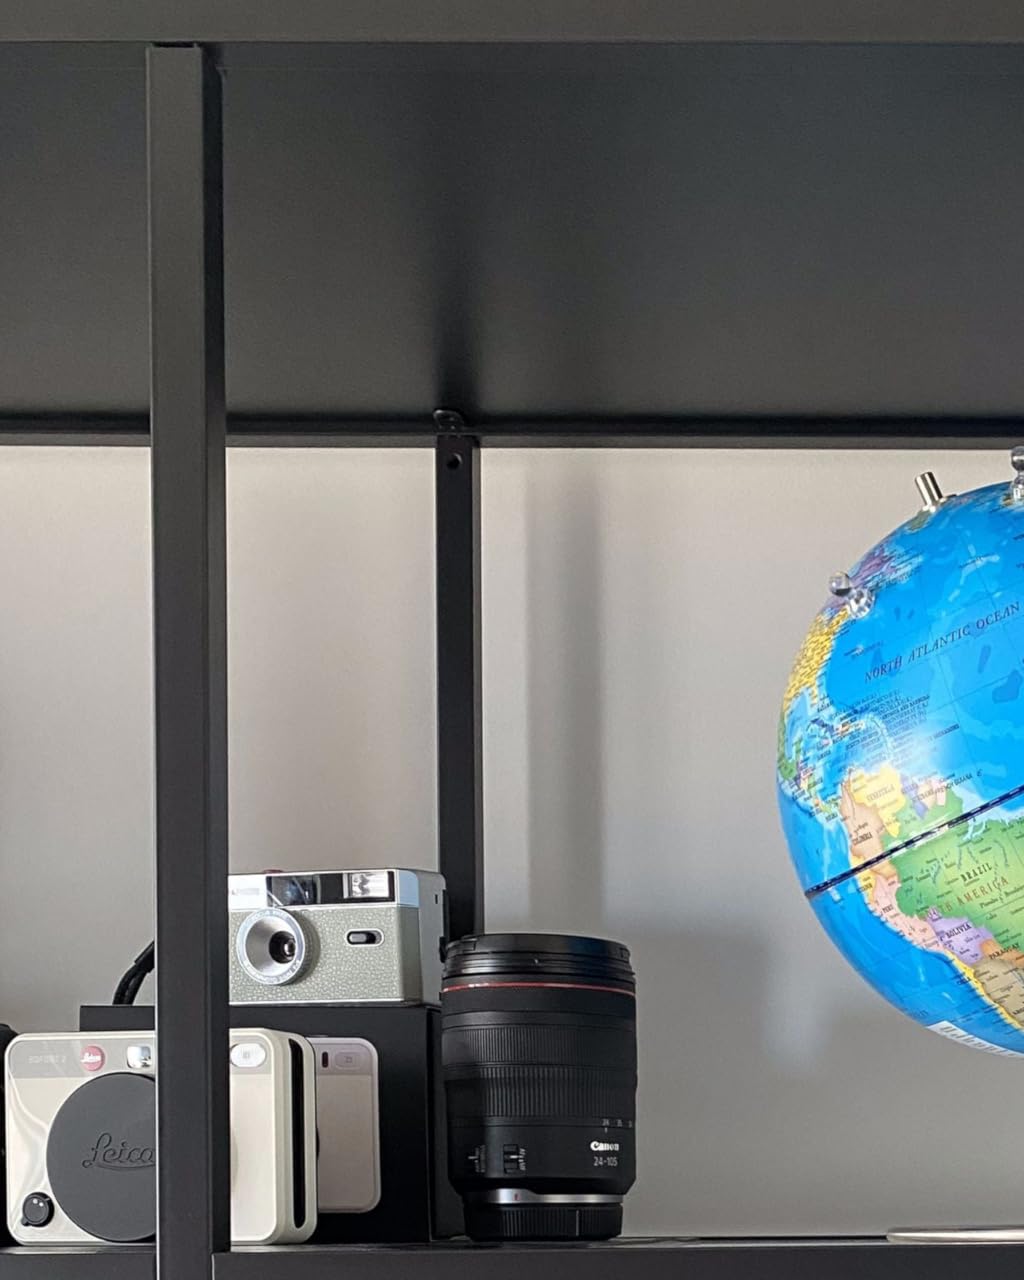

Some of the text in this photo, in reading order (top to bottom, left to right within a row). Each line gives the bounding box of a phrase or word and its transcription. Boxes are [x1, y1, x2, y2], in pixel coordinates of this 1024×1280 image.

[864, 656, 903, 683] NORTH
[907, 624, 971, 664] ATLANTIC
[976, 601, 1020, 630] OCEAN
[960, 863, 993, 882] BRAZIL
[956, 876, 1009, 906] AMERICA
[945, 922, 972, 938] BOLIVIA
[82, 1132, 156, 1169] Leica
[590, 1141, 619, 1151] Canon
[594, 1156, 618, 1166] 24-105
